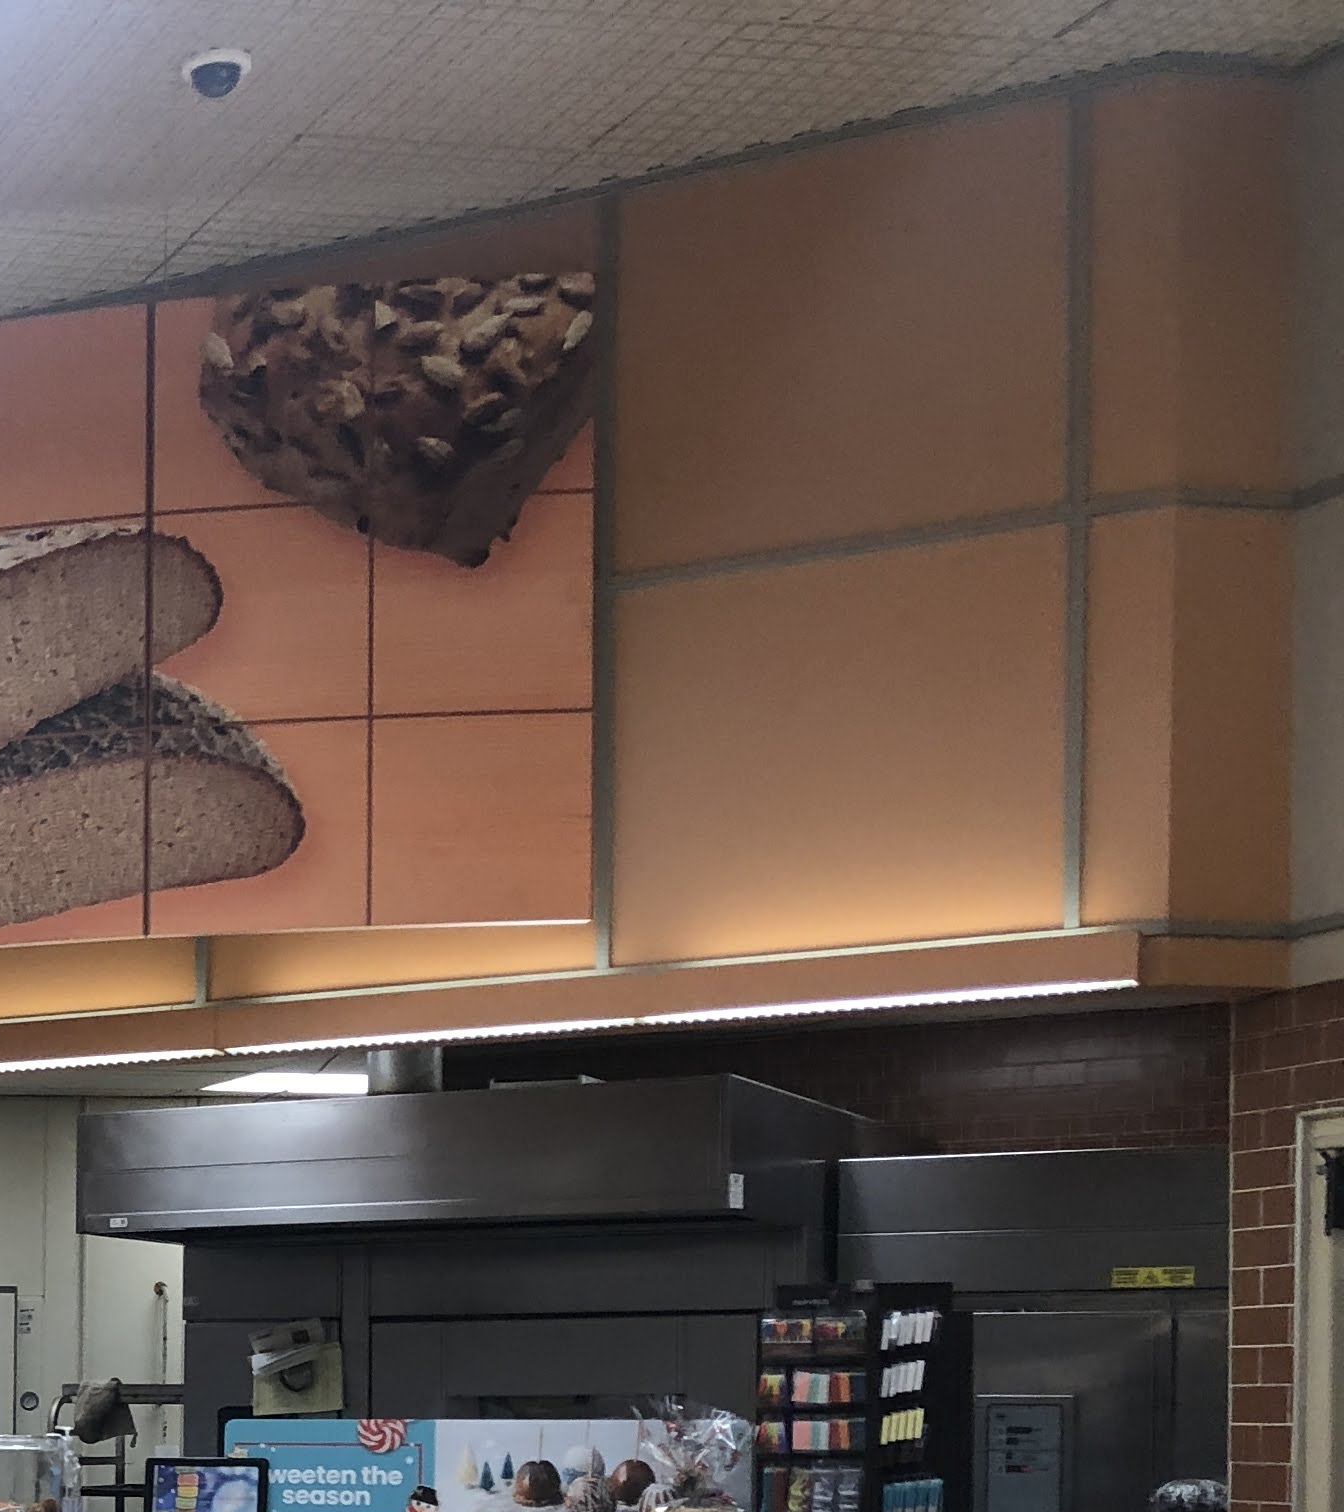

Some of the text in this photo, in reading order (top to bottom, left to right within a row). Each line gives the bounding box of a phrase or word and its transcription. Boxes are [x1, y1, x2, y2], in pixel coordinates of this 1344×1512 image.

[269, 1466, 404, 1485] weeten the
[282, 1489, 371, 1506] season
